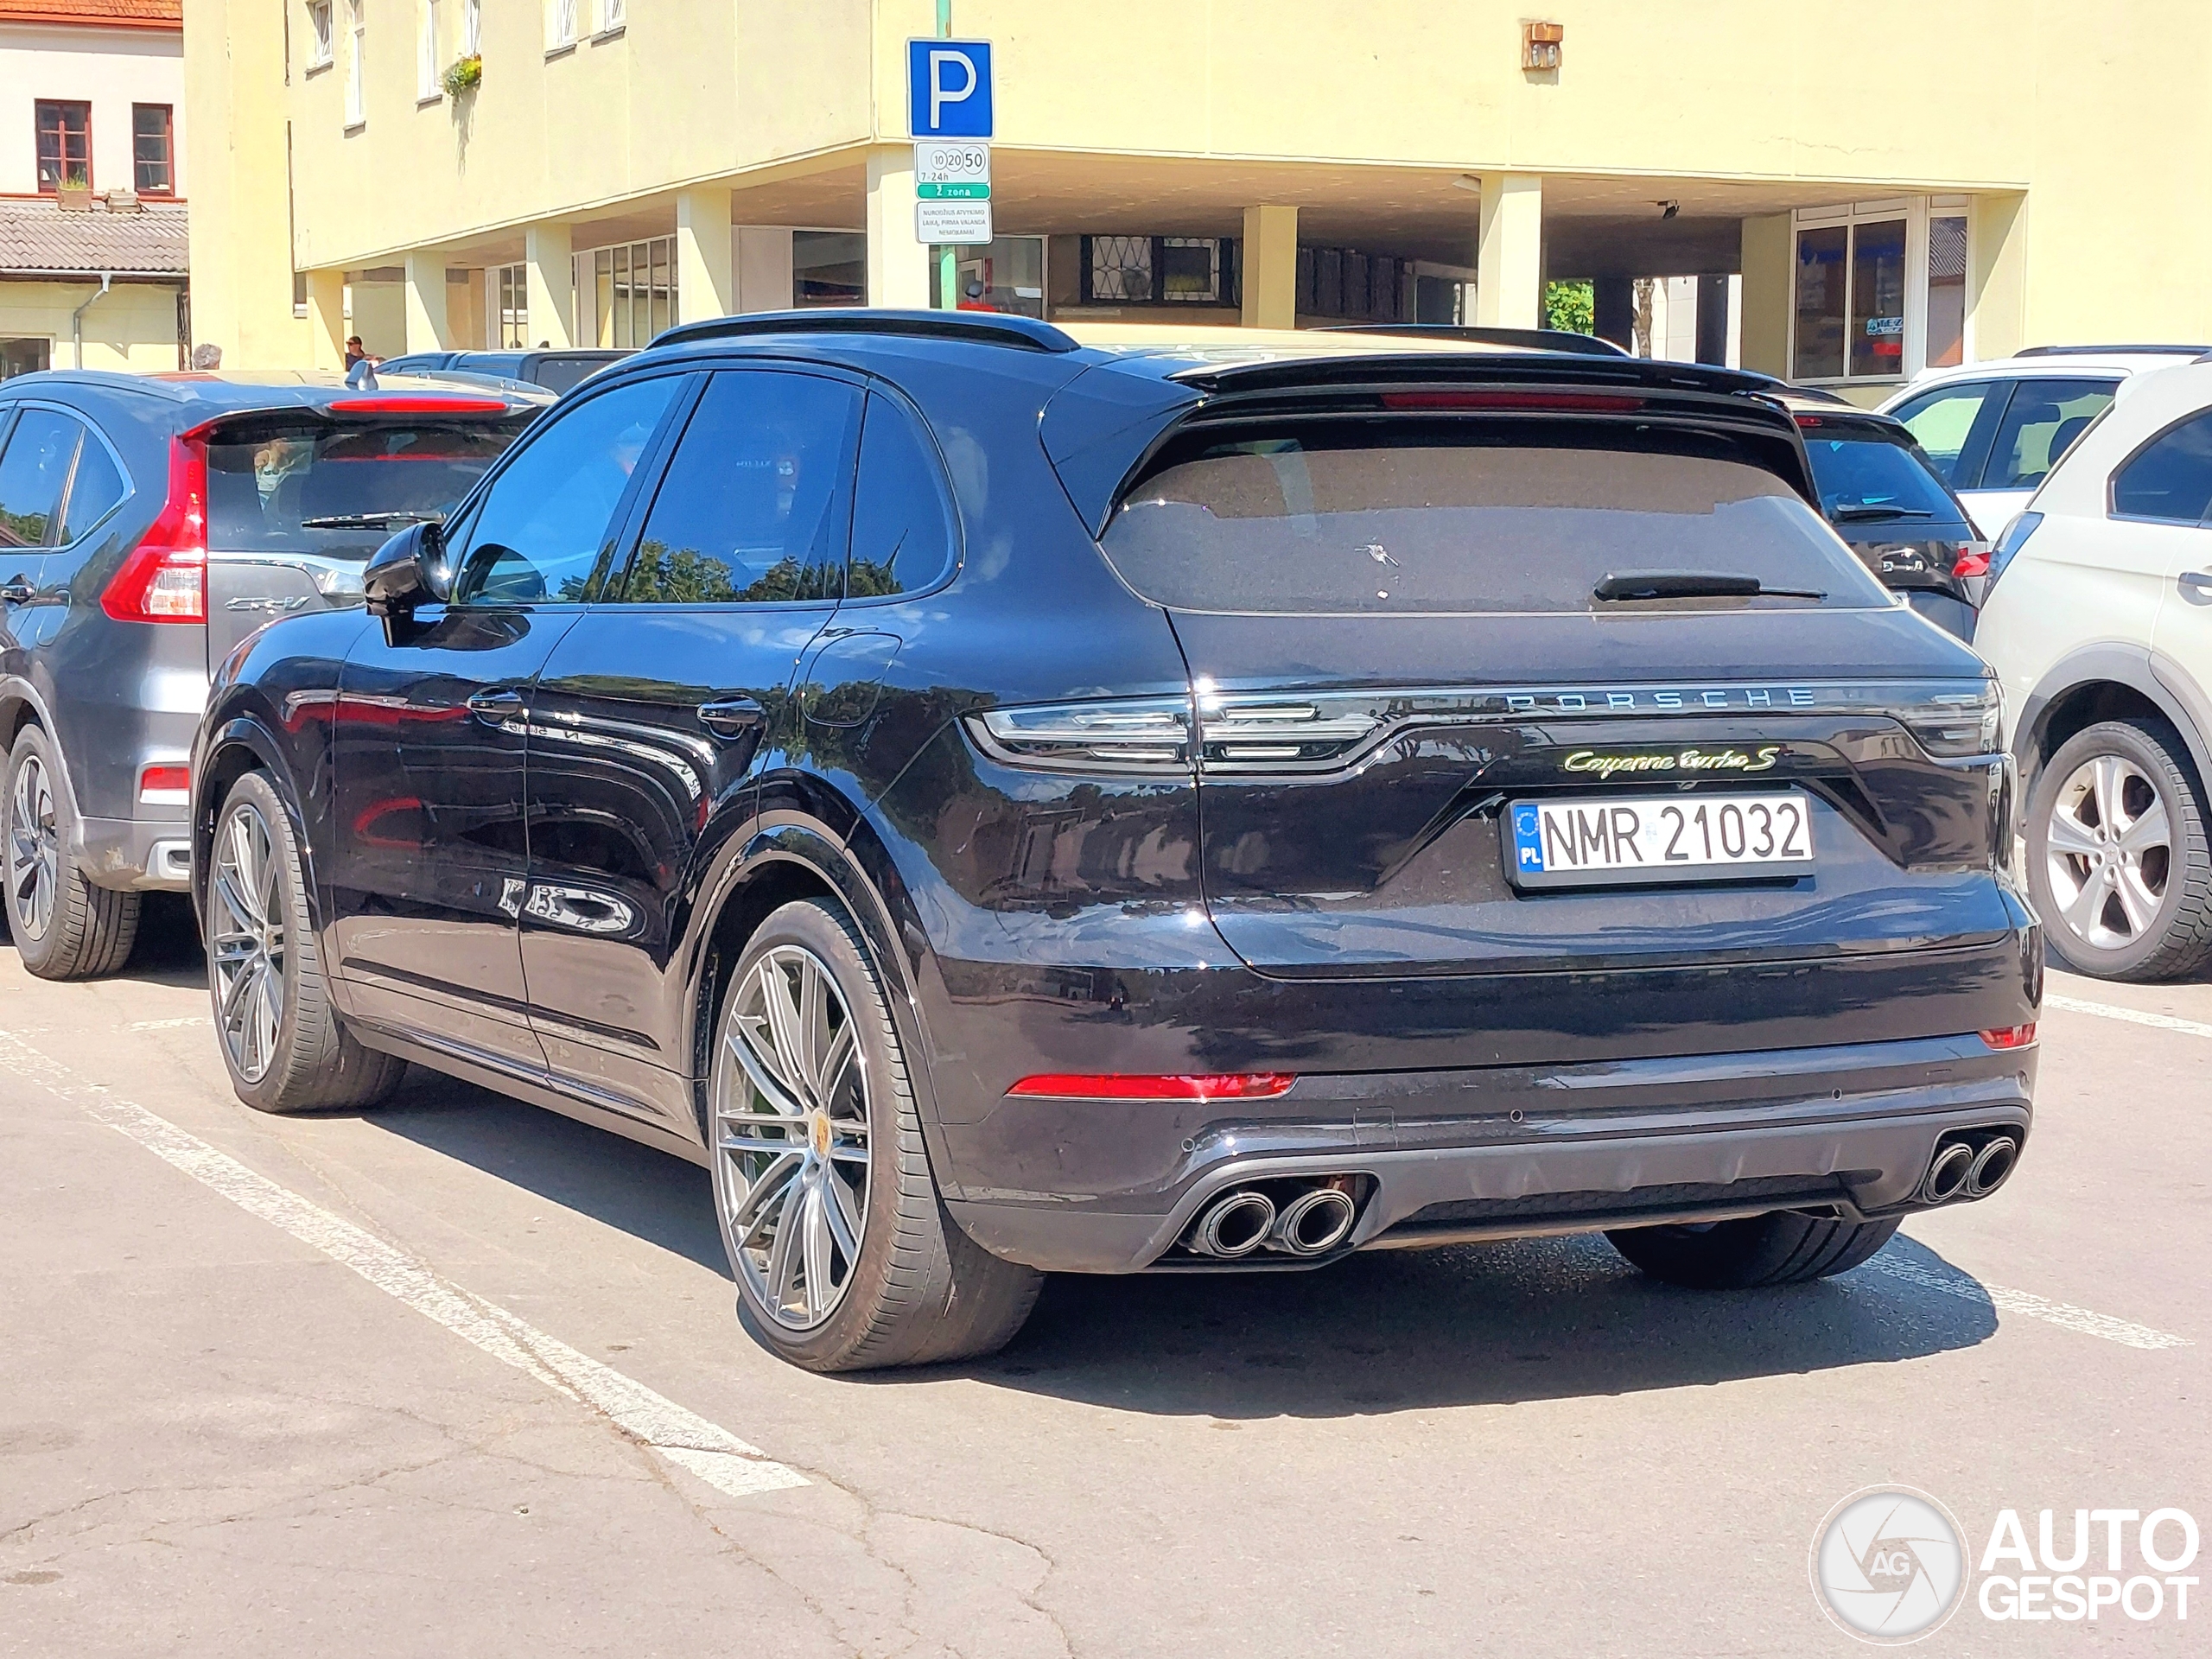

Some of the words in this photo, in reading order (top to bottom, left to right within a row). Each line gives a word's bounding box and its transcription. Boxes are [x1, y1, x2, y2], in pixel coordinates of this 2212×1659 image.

[930, 49, 977, 130] P
[935, 156, 944, 165] 10
[948, 155, 962, 166] 20
[965, 153, 982, 168] 50
[1506, 688, 1816, 712] PORSCHE
[1564, 750, 1675, 779] Cayenne
[1743, 747, 1781, 772] S
[1543, 807, 1643, 867] NMR
[1659, 803, 1806, 861] 21032
[1521, 847, 1541, 865] PL
